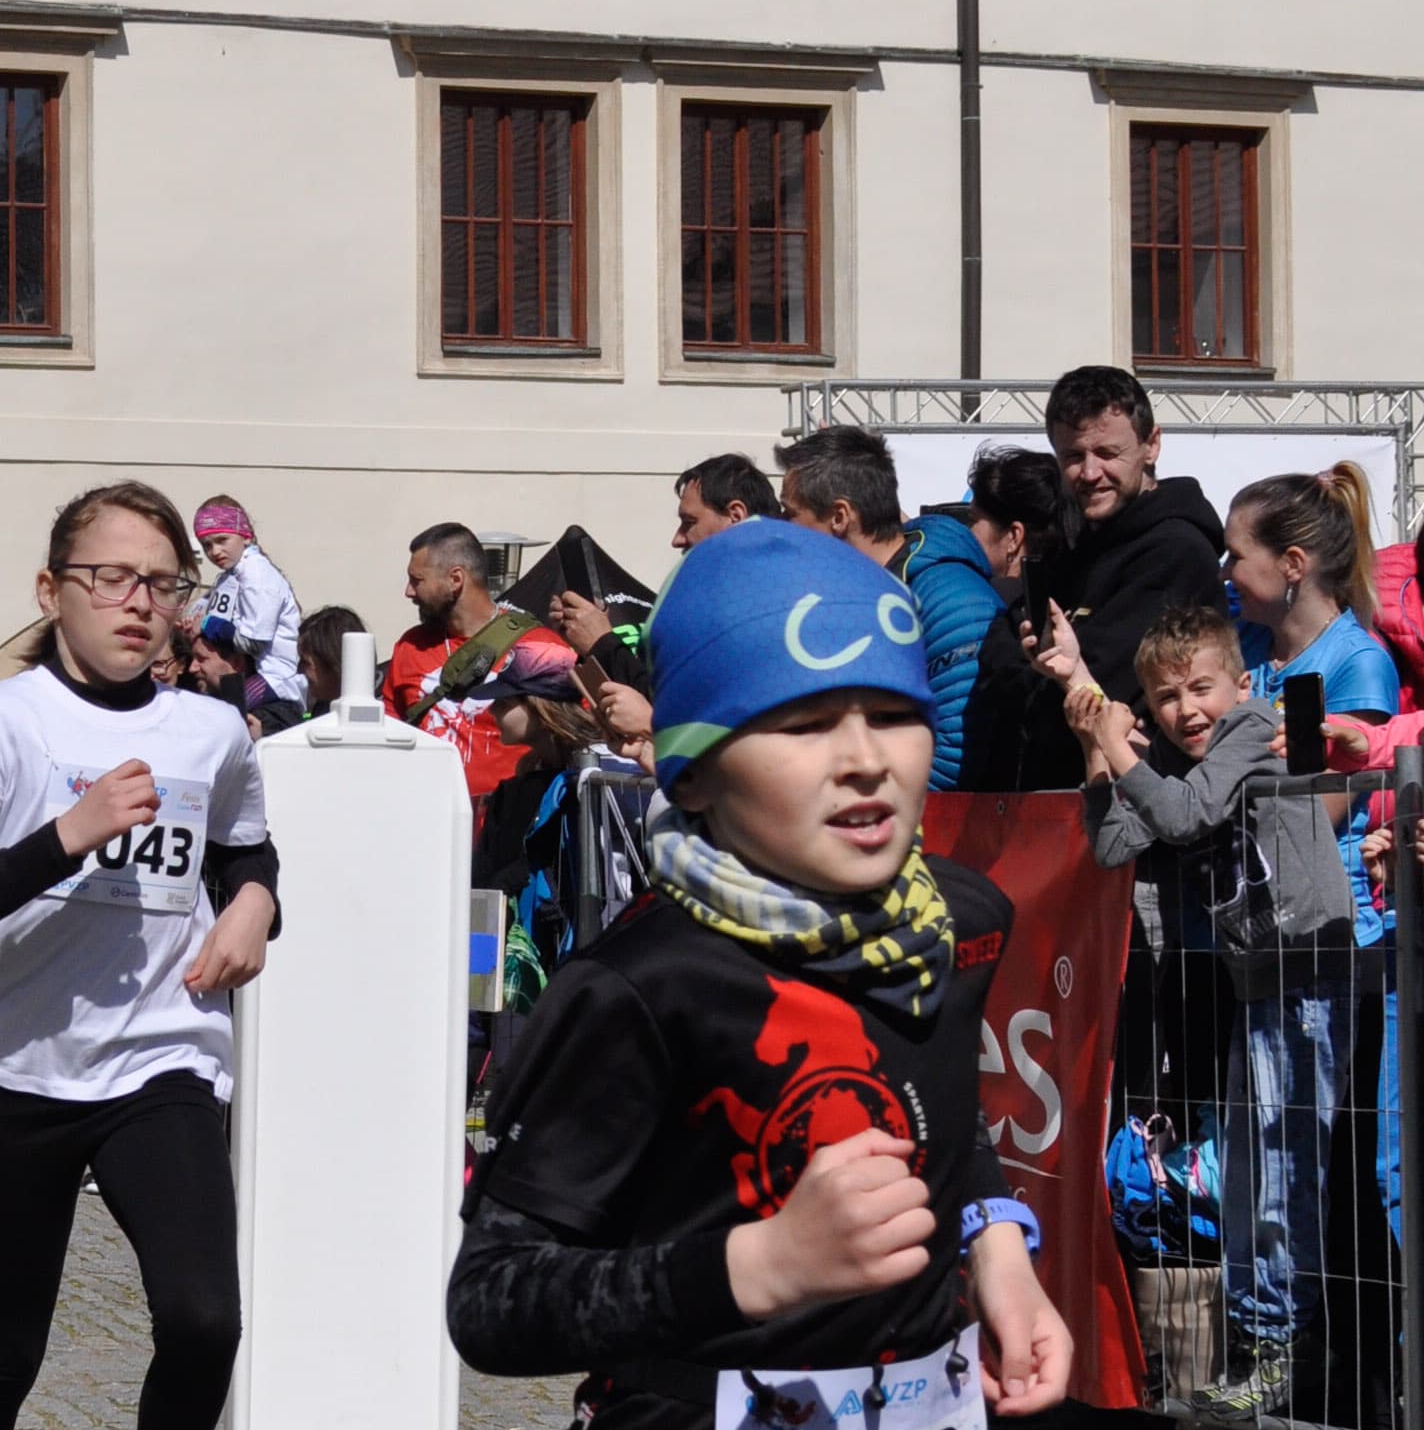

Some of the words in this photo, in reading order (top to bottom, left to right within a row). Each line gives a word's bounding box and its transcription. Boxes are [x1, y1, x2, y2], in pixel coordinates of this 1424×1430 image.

[93, 825, 194, 878] 043
[903, 1081, 928, 1141] SPARTAN
[881, 1378, 928, 1403] VZP
